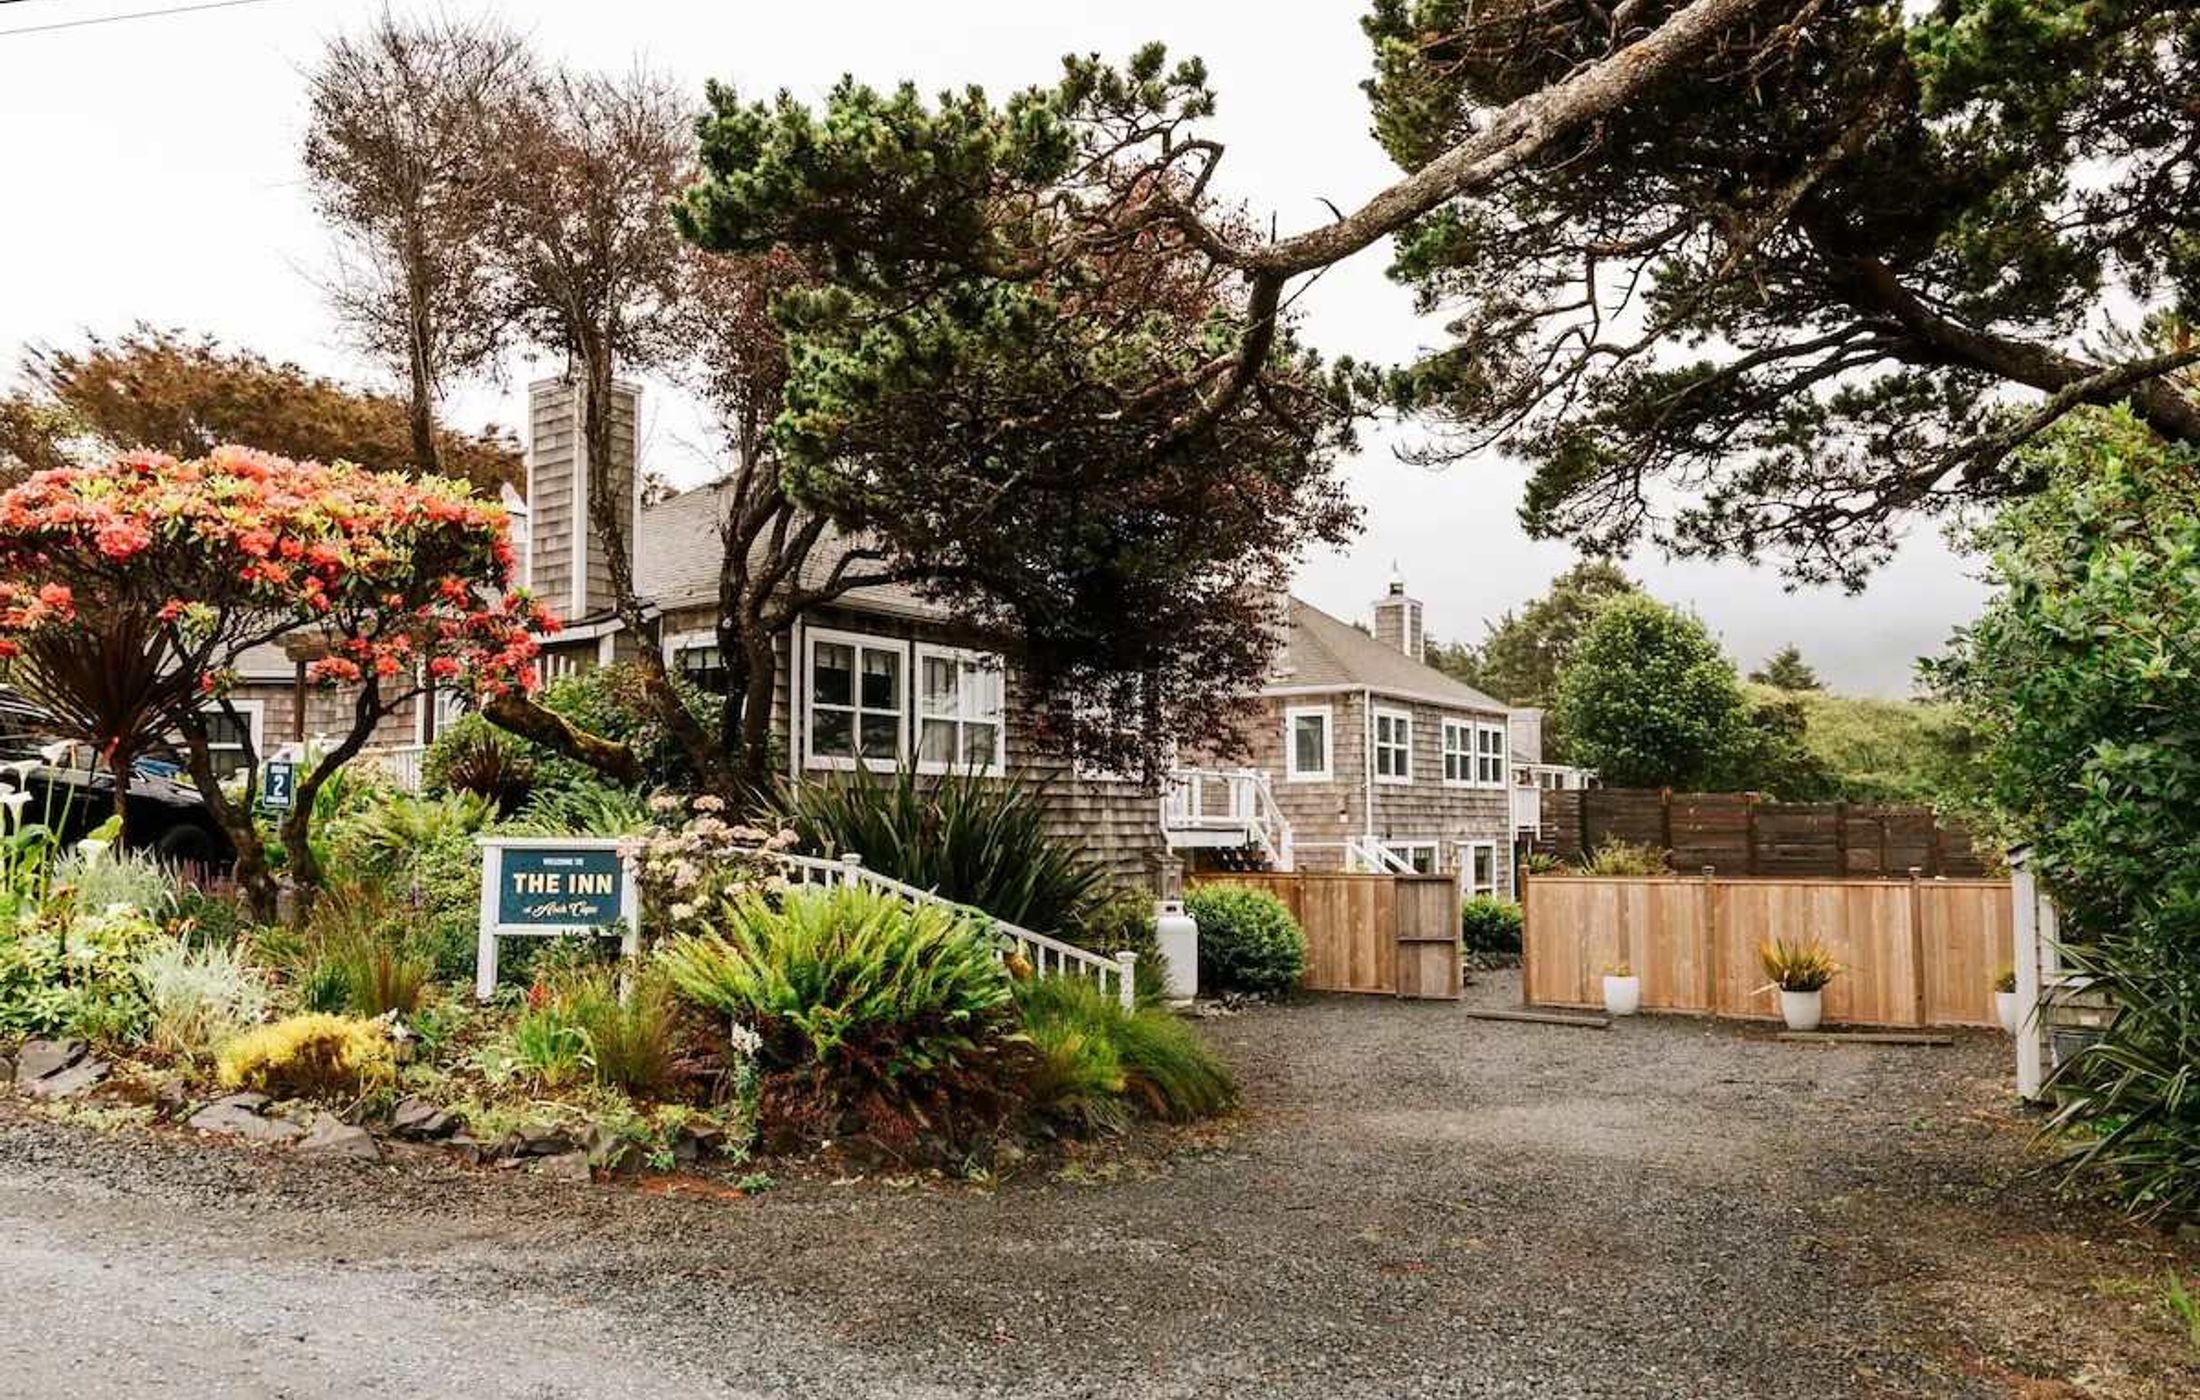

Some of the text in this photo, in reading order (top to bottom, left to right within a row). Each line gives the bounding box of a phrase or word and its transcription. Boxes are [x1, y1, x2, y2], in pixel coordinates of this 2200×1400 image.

[274, 774, 284, 796] 2
[513, 873, 613, 894] THE INN
